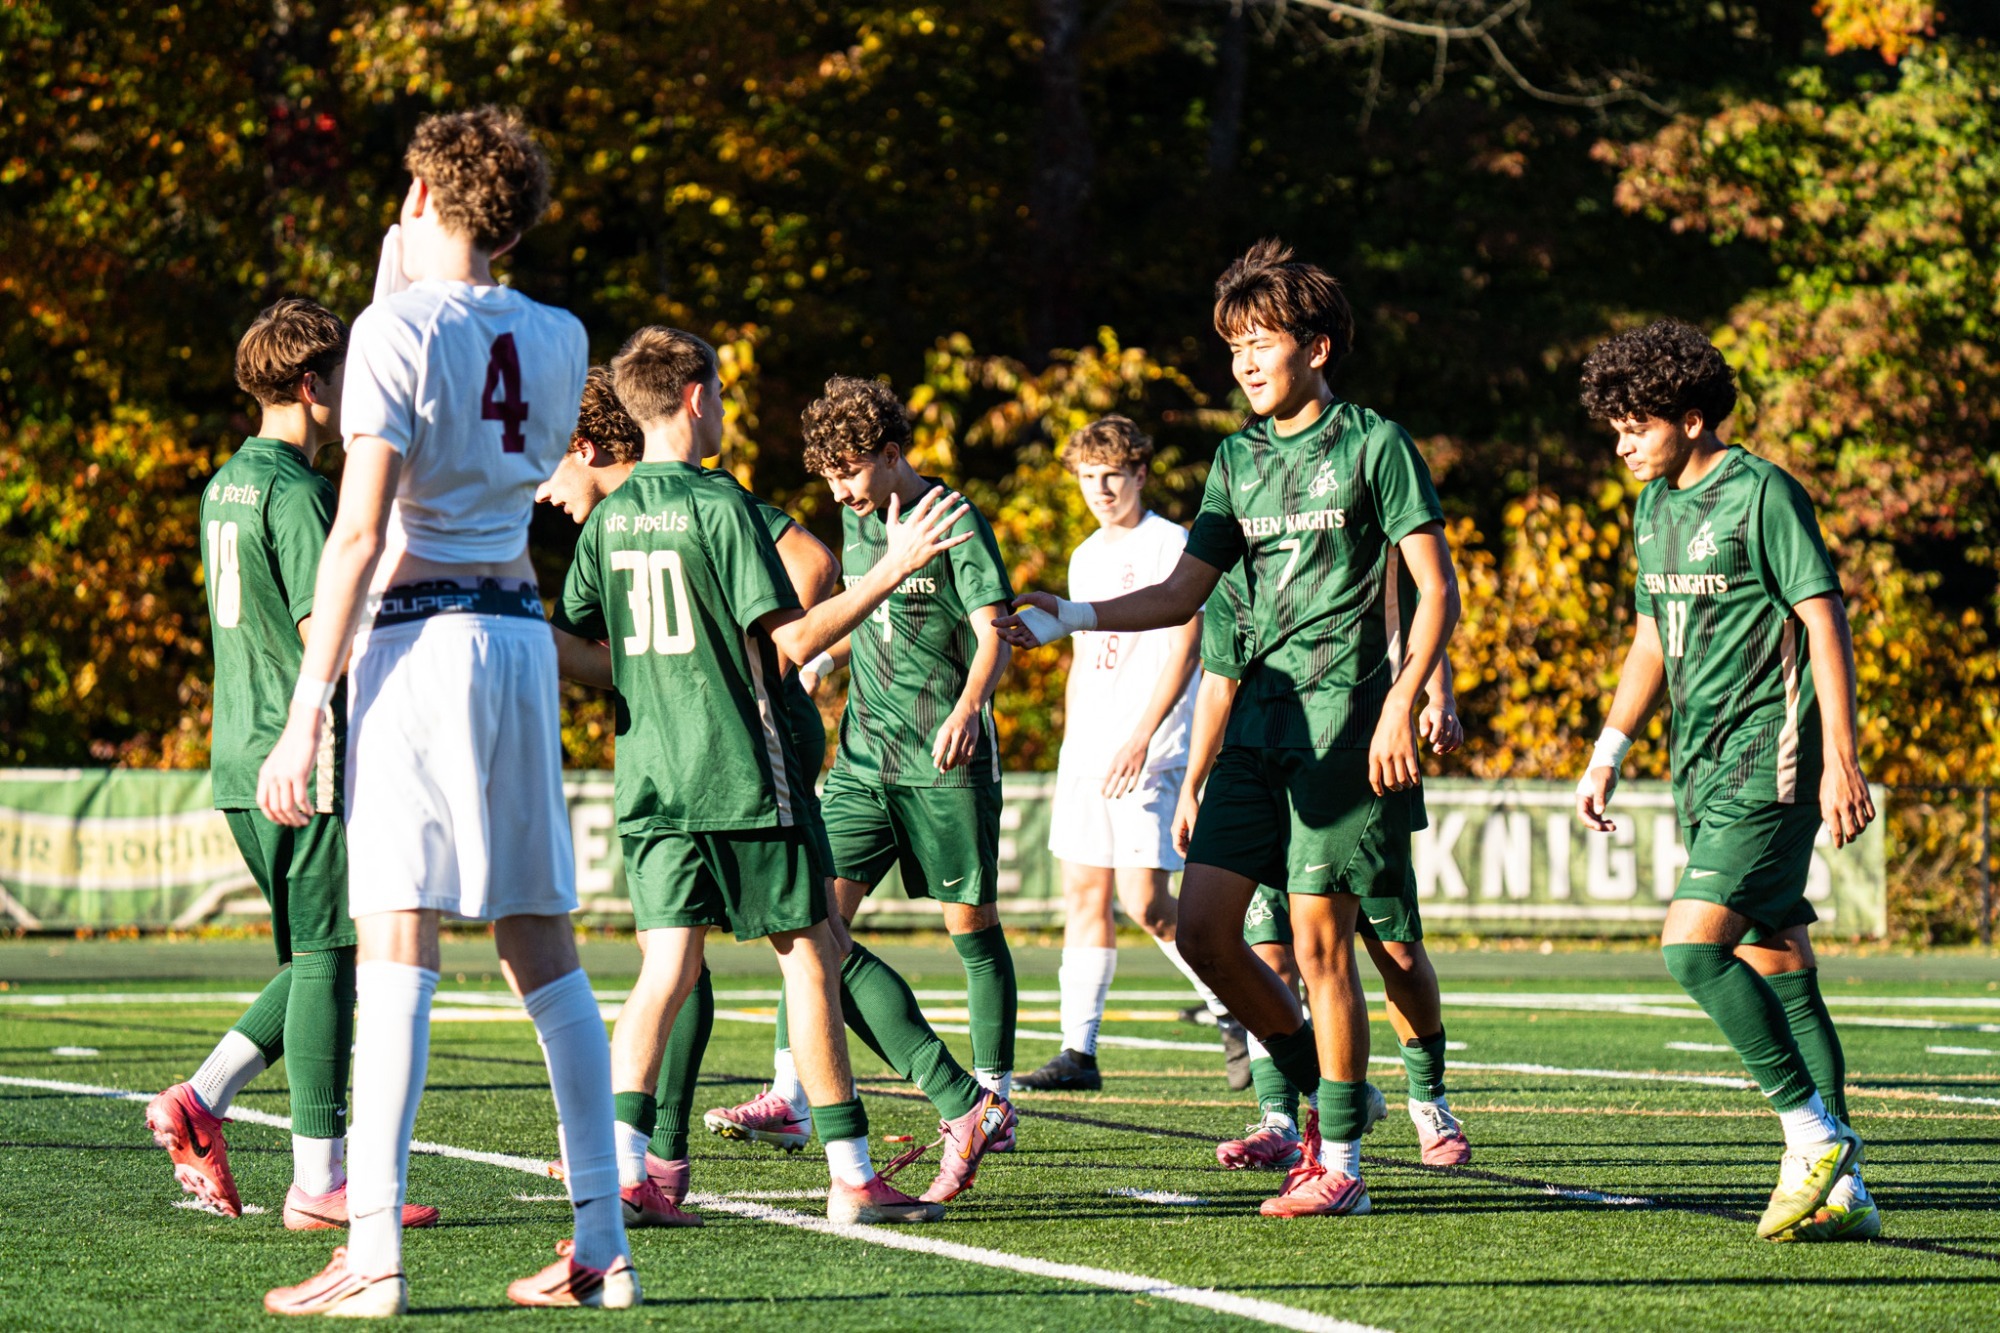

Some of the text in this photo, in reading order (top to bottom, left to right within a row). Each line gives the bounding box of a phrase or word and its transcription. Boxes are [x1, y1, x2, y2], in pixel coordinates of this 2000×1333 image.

[481, 332, 529, 453] 4
[1238, 508, 1346, 537] REEN KNIGHTS
[207, 519, 241, 629] 18
[892, 577, 936, 594] GHTS
[1279, 538, 1301, 591] 7
[1644, 573, 1728, 595] EEN KNIGHTS
[610, 550, 696, 656] 30
[1666, 600, 1687, 657] 11
[0, 827, 50, 862] IR
[1414, 811, 1833, 900] KNIGH
